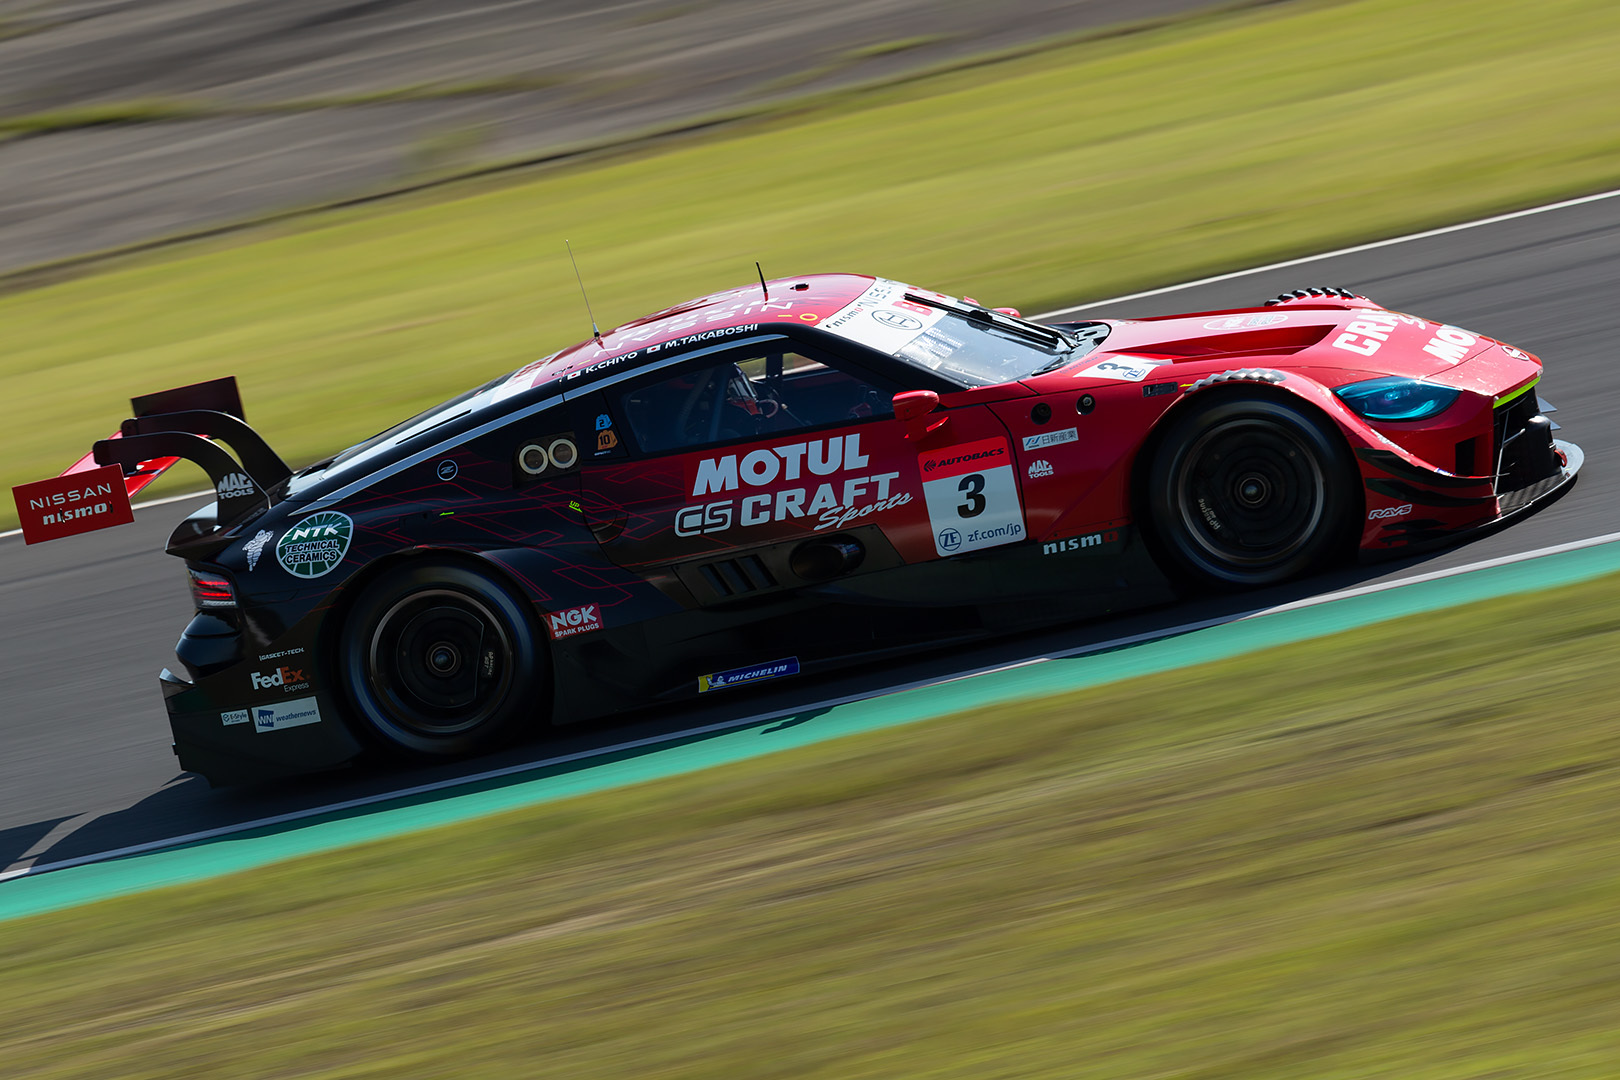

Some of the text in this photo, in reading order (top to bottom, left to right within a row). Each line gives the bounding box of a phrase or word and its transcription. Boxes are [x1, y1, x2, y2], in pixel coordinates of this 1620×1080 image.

[664, 323, 759, 350] M.TAKABOSHI
[585, 351, 638, 374] K.CHIYO
[598, 419, 605, 428] 2
[599, 434, 610, 446] 10
[692, 433, 870, 497] MOTUL
[937, 447, 1004, 468] AUTOBACS
[1027, 459, 1053, 475] MAC
[217, 472, 254, 493] MAC
[1028, 469, 1054, 479] TOOLS
[29, 482, 113, 511] NISSAN
[218, 487, 255, 500] TOOLS
[740, 471, 900, 528] CRAFT
[957, 473, 986, 519] 3
[42, 502, 109, 526] nismo
[570, 500, 580, 508] UP
[813, 492, 914, 531] Sports
[1368, 504, 1412, 520] RAYS
[291, 523, 343, 541] NTK
[939, 522, 1022, 549] ZF zf.com/jp
[285, 539, 339, 554] TECHNICAL
[1043, 530, 1119, 555] nismo
[286, 551, 337, 565] CERAMICS
[550, 604, 598, 630] NGK
[554, 622, 600, 638] SPARK PLUGS
[250, 665, 305, 690] FedEx
[727, 664, 788, 683] MICHELIN
[283, 682, 310, 693] Express
[275, 709, 317, 722] weathernews
